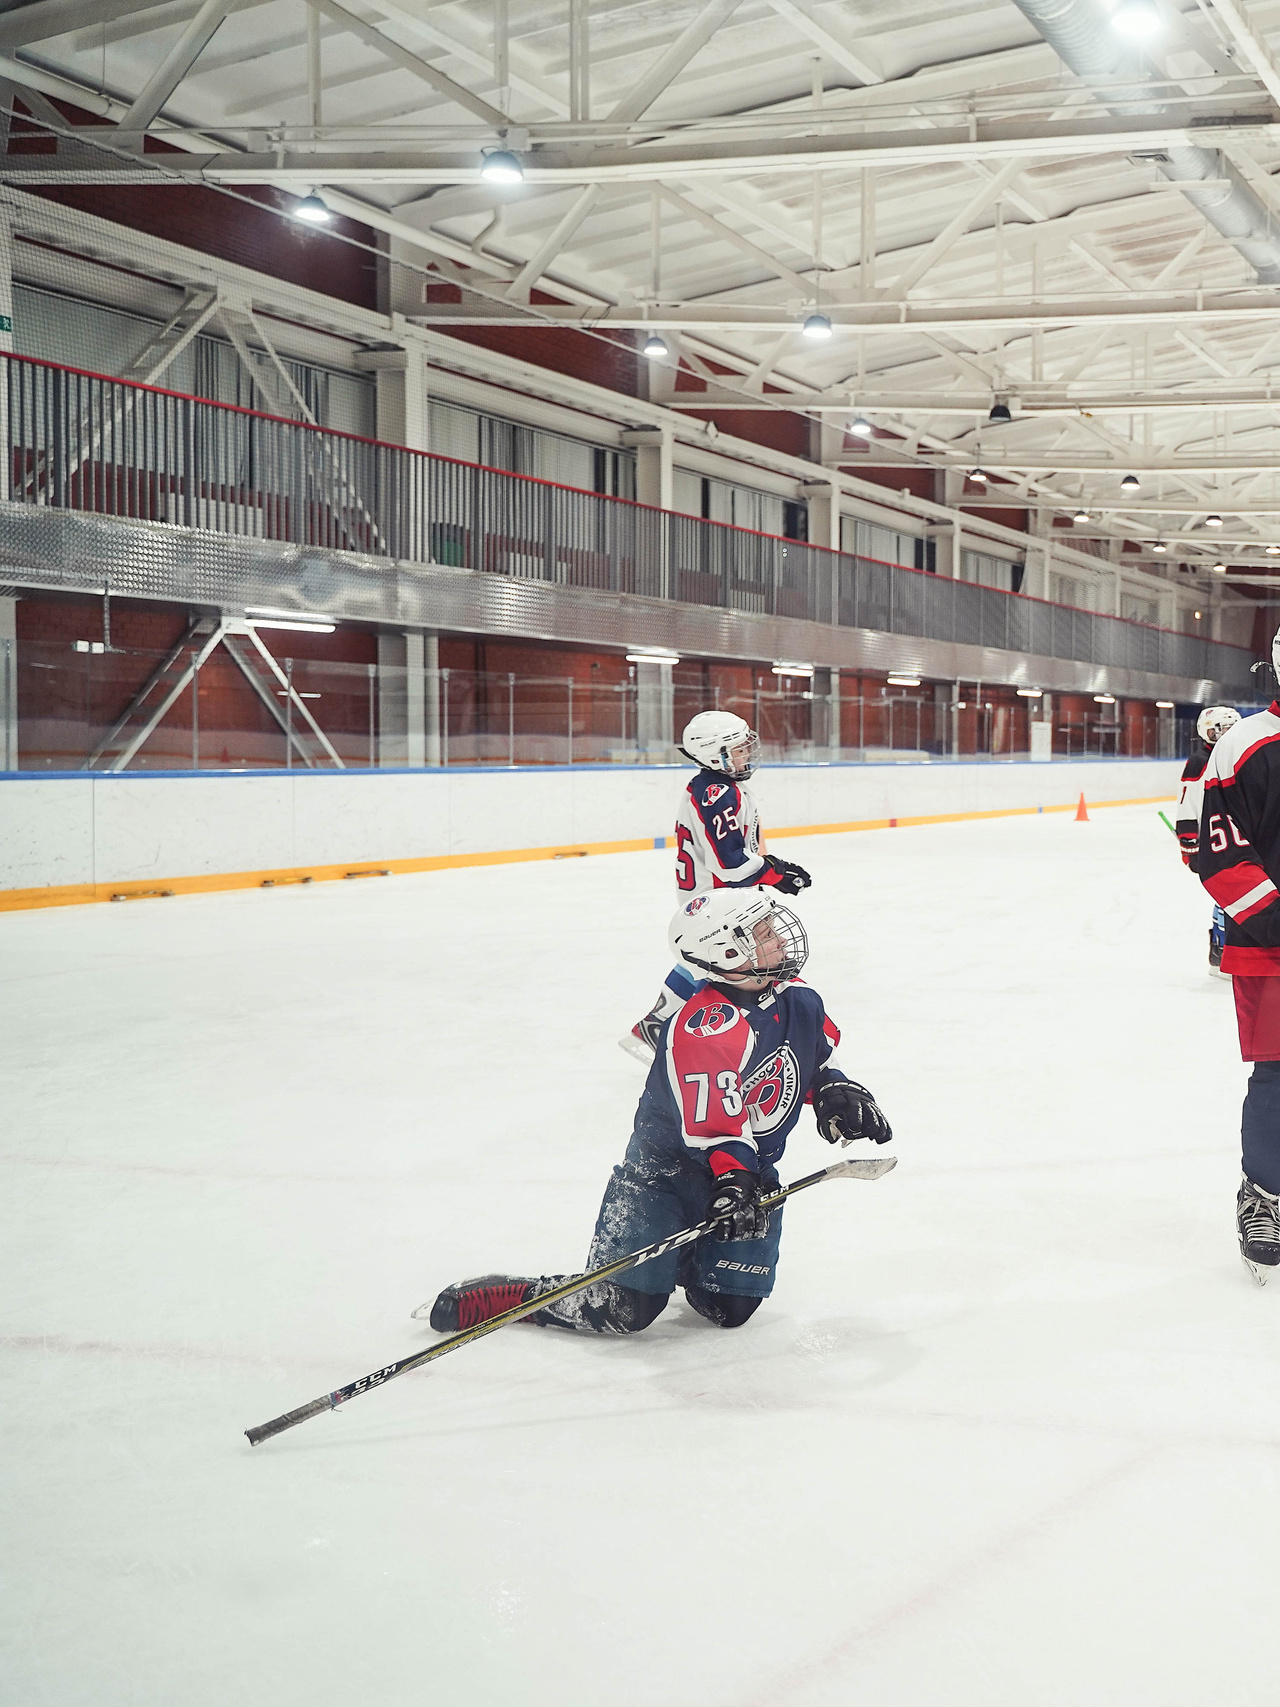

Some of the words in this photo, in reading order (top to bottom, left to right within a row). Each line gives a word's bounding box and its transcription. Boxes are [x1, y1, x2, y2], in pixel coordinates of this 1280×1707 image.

[712, 806, 740, 841] 25
[699, 929, 721, 942] BAUER
[684, 1070, 744, 1123] 73
[781, 1073, 794, 1109] VIKHR
[760, 1185, 790, 1202] CCM
[715, 1259, 771, 1275] BAUER
[355, 1363, 397, 1389] CCM
